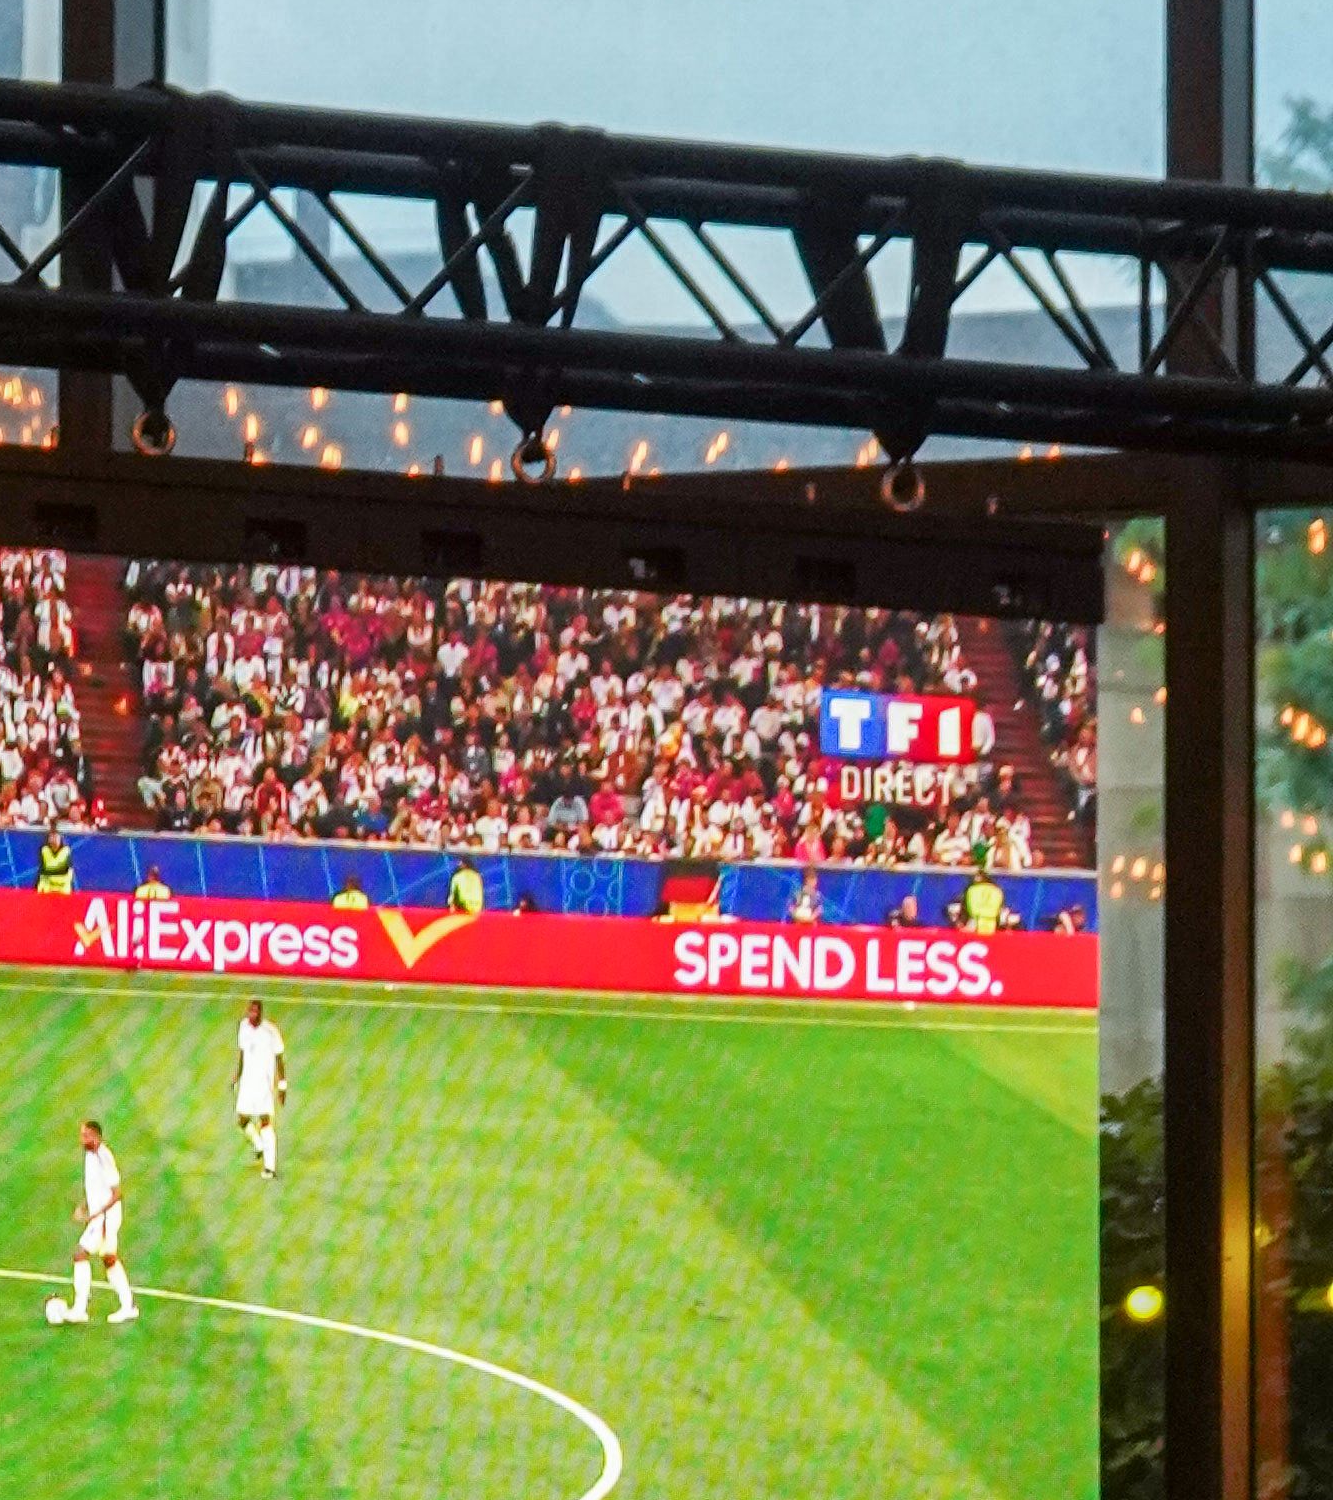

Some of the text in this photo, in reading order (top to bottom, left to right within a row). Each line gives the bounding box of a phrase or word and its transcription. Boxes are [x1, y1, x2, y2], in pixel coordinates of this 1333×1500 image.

[830, 697, 962, 757] TF1
[840, 764, 953, 807] DIRECT
[74, 897, 360, 972] AliExpress
[673, 930, 1004, 998] SPEND LESS.
